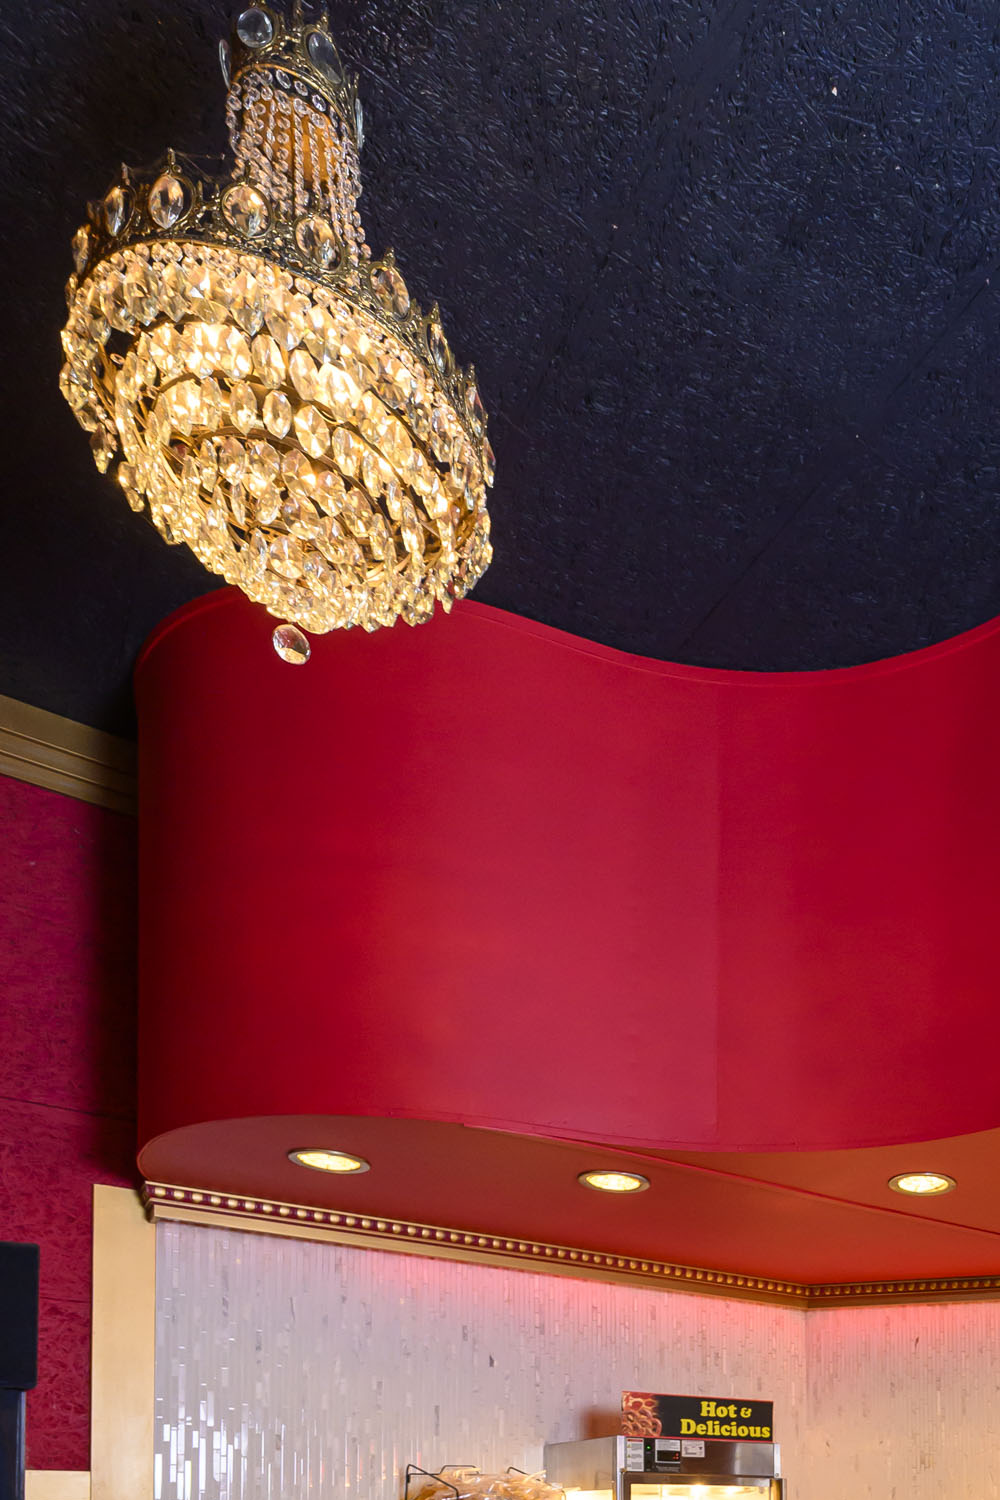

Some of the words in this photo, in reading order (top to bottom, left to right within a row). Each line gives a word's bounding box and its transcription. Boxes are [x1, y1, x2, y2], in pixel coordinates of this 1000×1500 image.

[700, 1401, 737, 1418] Hot
[740, 1407, 752, 1418] &
[680, 1418, 771, 1438] Delicious
